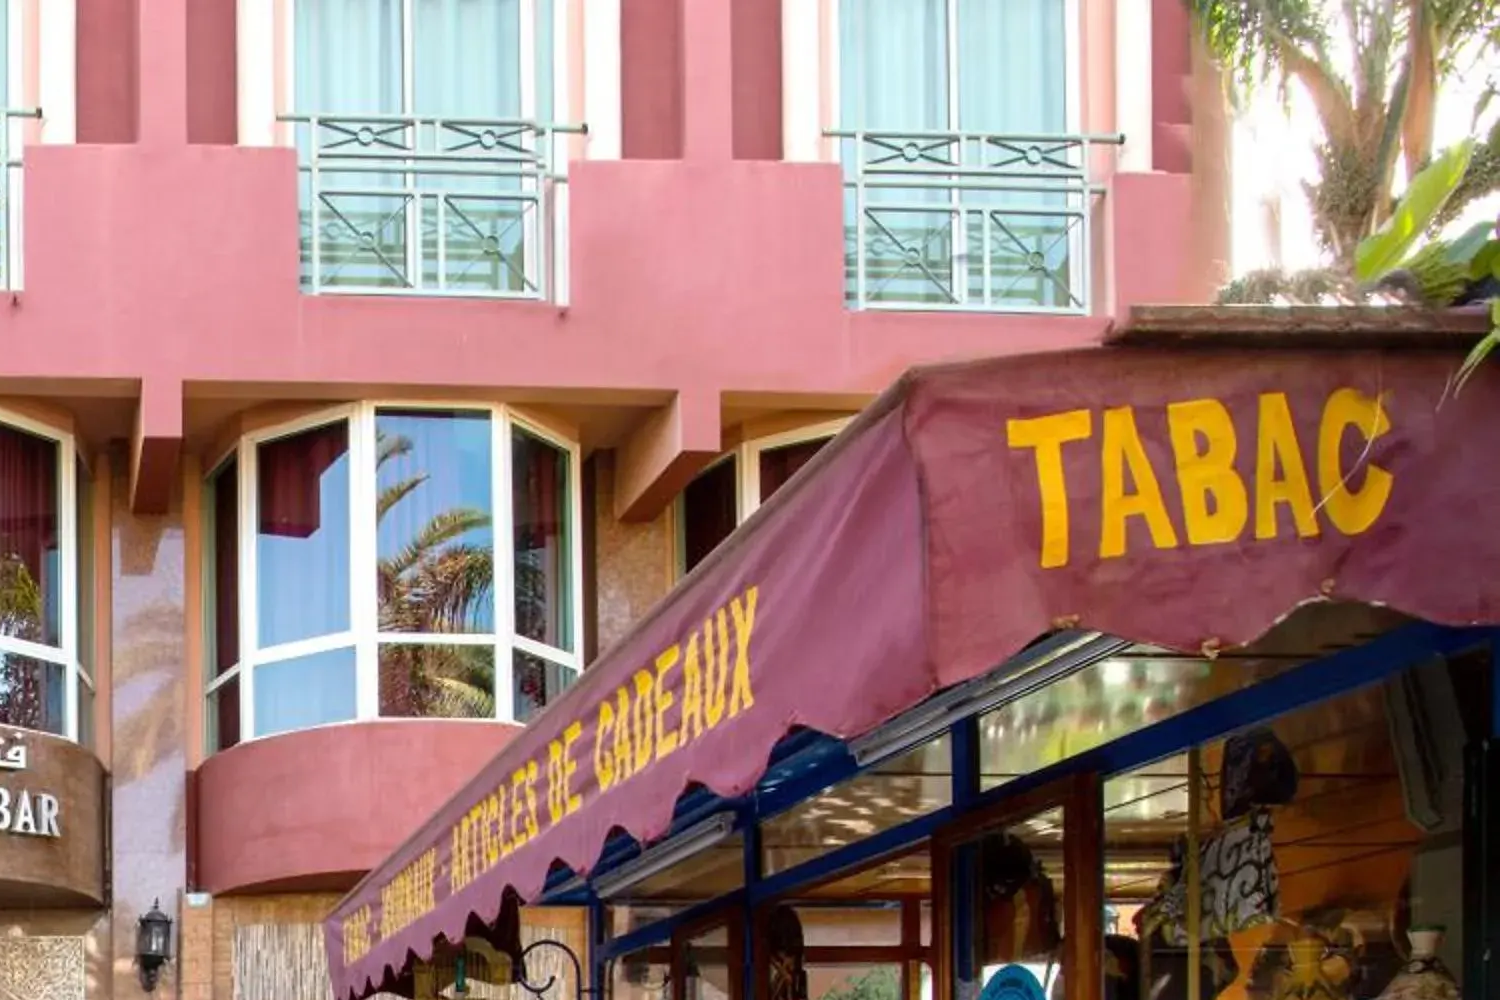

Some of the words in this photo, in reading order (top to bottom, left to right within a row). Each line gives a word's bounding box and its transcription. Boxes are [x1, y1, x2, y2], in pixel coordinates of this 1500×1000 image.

[1006, 387, 1394, 568] TABAC
[450, 760, 540, 896] ARTICLES
[547, 721, 583, 825] DE
[593, 586, 759, 791] CADEAUX
